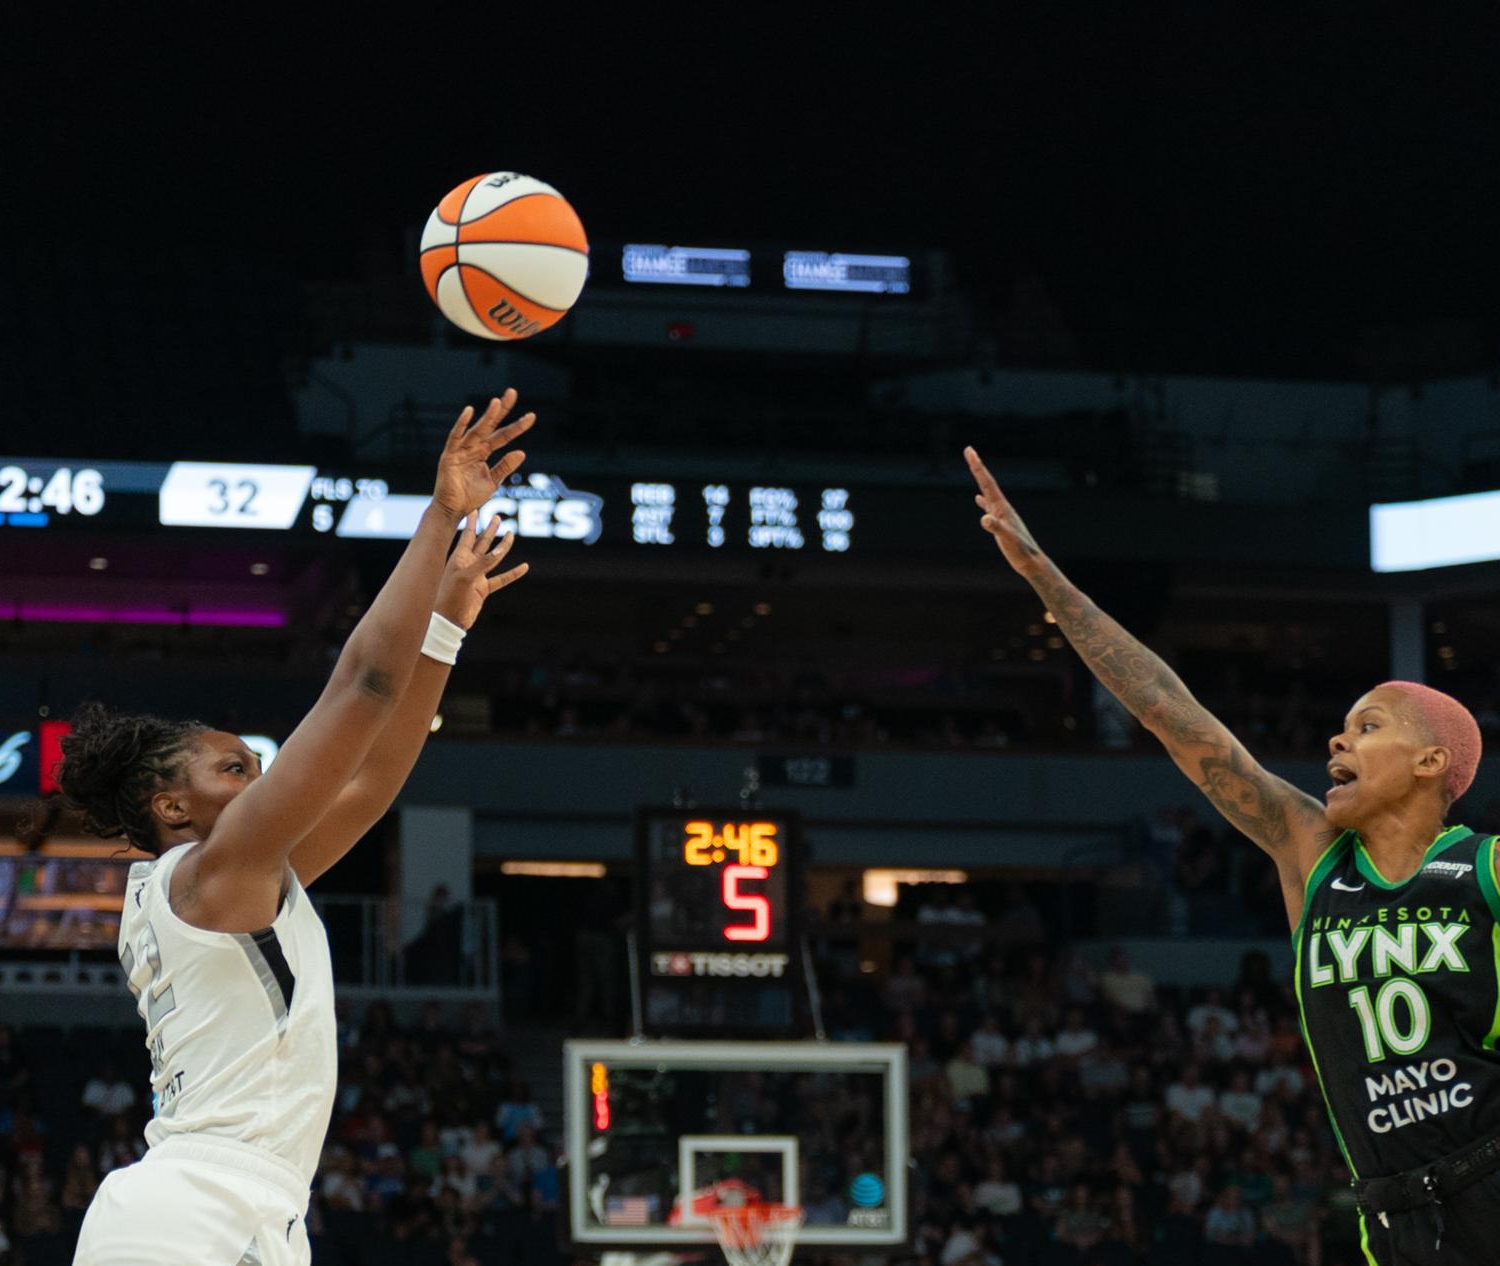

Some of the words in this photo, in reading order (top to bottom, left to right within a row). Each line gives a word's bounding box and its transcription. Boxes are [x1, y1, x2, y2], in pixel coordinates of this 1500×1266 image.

[206, 477, 259, 516] 32
[458, 496, 594, 539] CES
[684, 820, 779, 867] 2:46
[722, 863, 772, 942] 5
[690, 953, 789, 978] TISSOT
[1309, 921, 1470, 988] LYNX
[1349, 976, 1432, 1063] 10
[1364, 1058, 1458, 1103] MAYO
[1367, 1083, 1474, 1135] CLINIC
